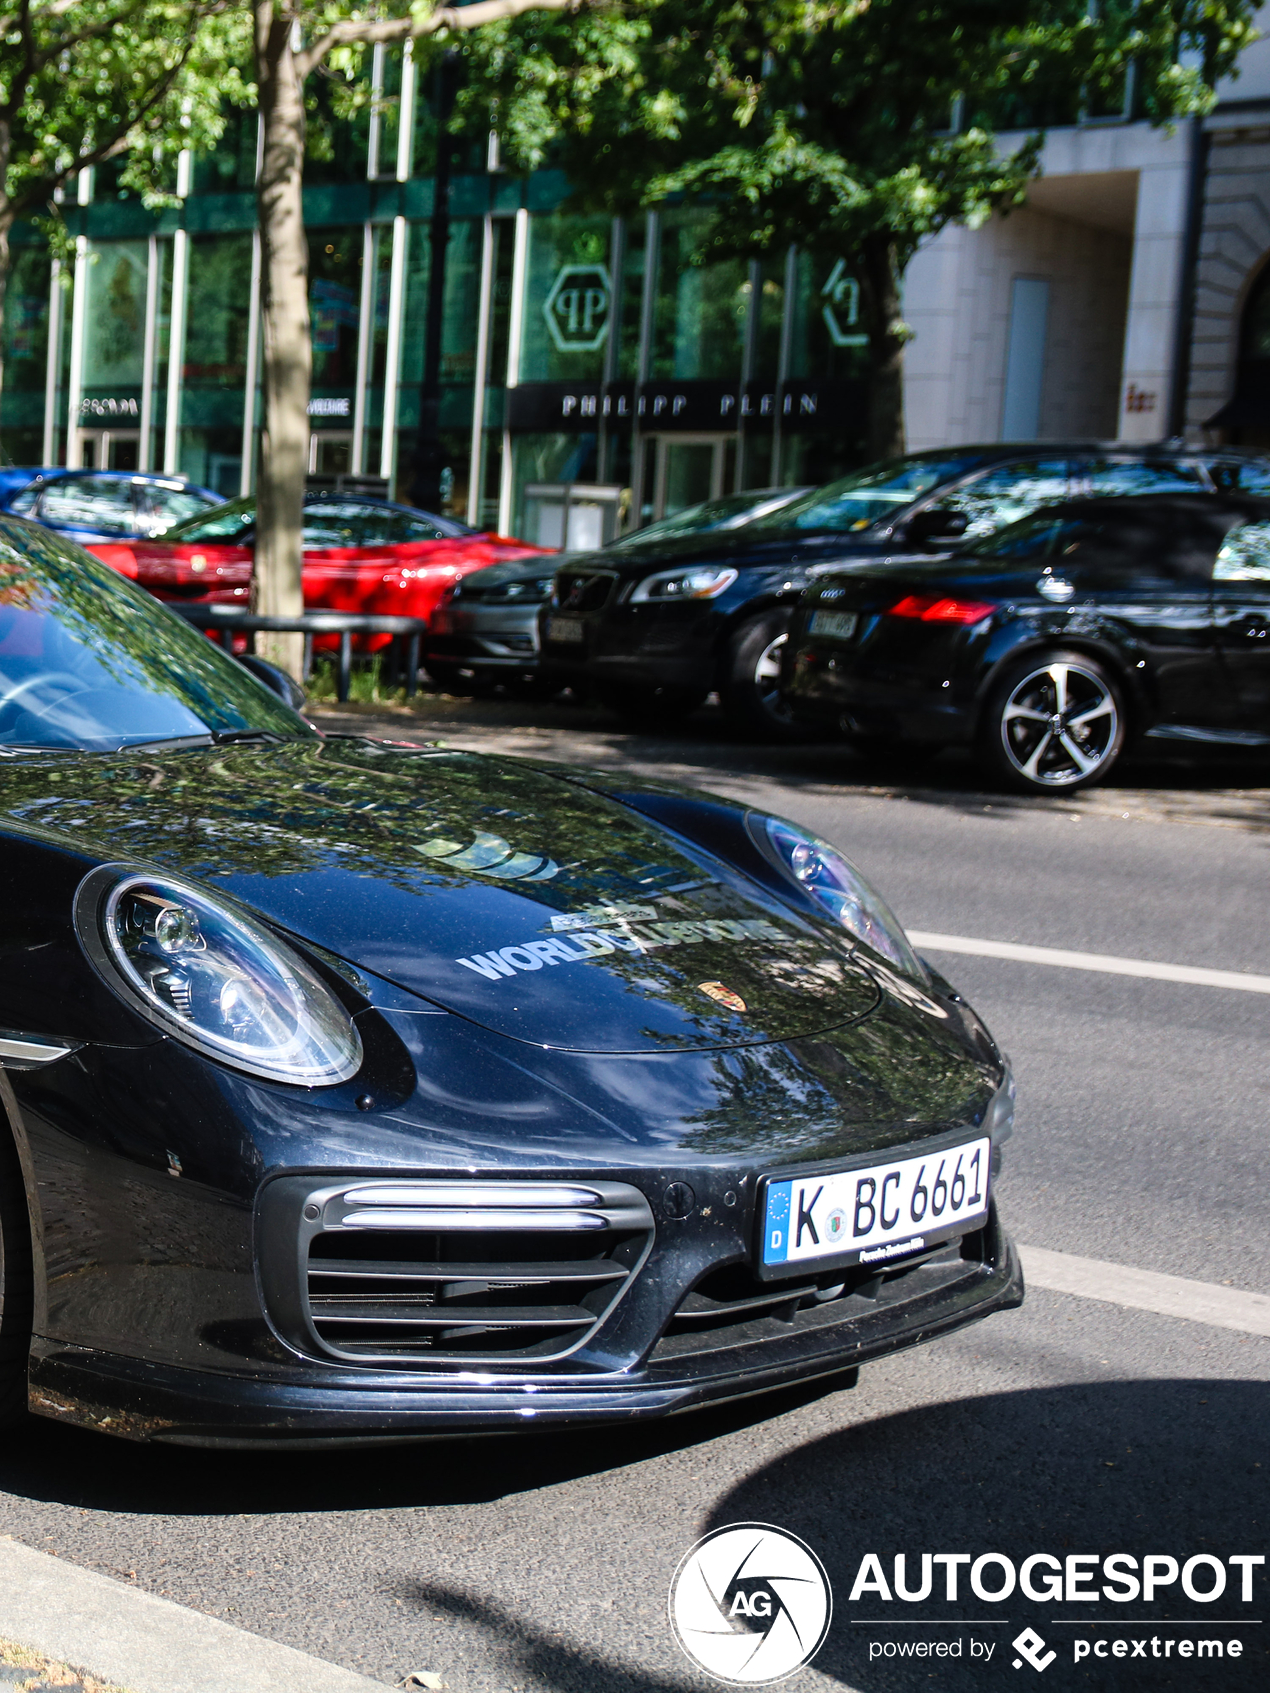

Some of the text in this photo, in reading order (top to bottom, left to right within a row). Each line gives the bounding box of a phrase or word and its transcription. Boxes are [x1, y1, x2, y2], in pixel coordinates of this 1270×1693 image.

[562, 394, 818, 417] PHILIPP PLEIN
[795, 1148, 982, 1248] K BC 6661
[771, 1230, 782, 1249] D
